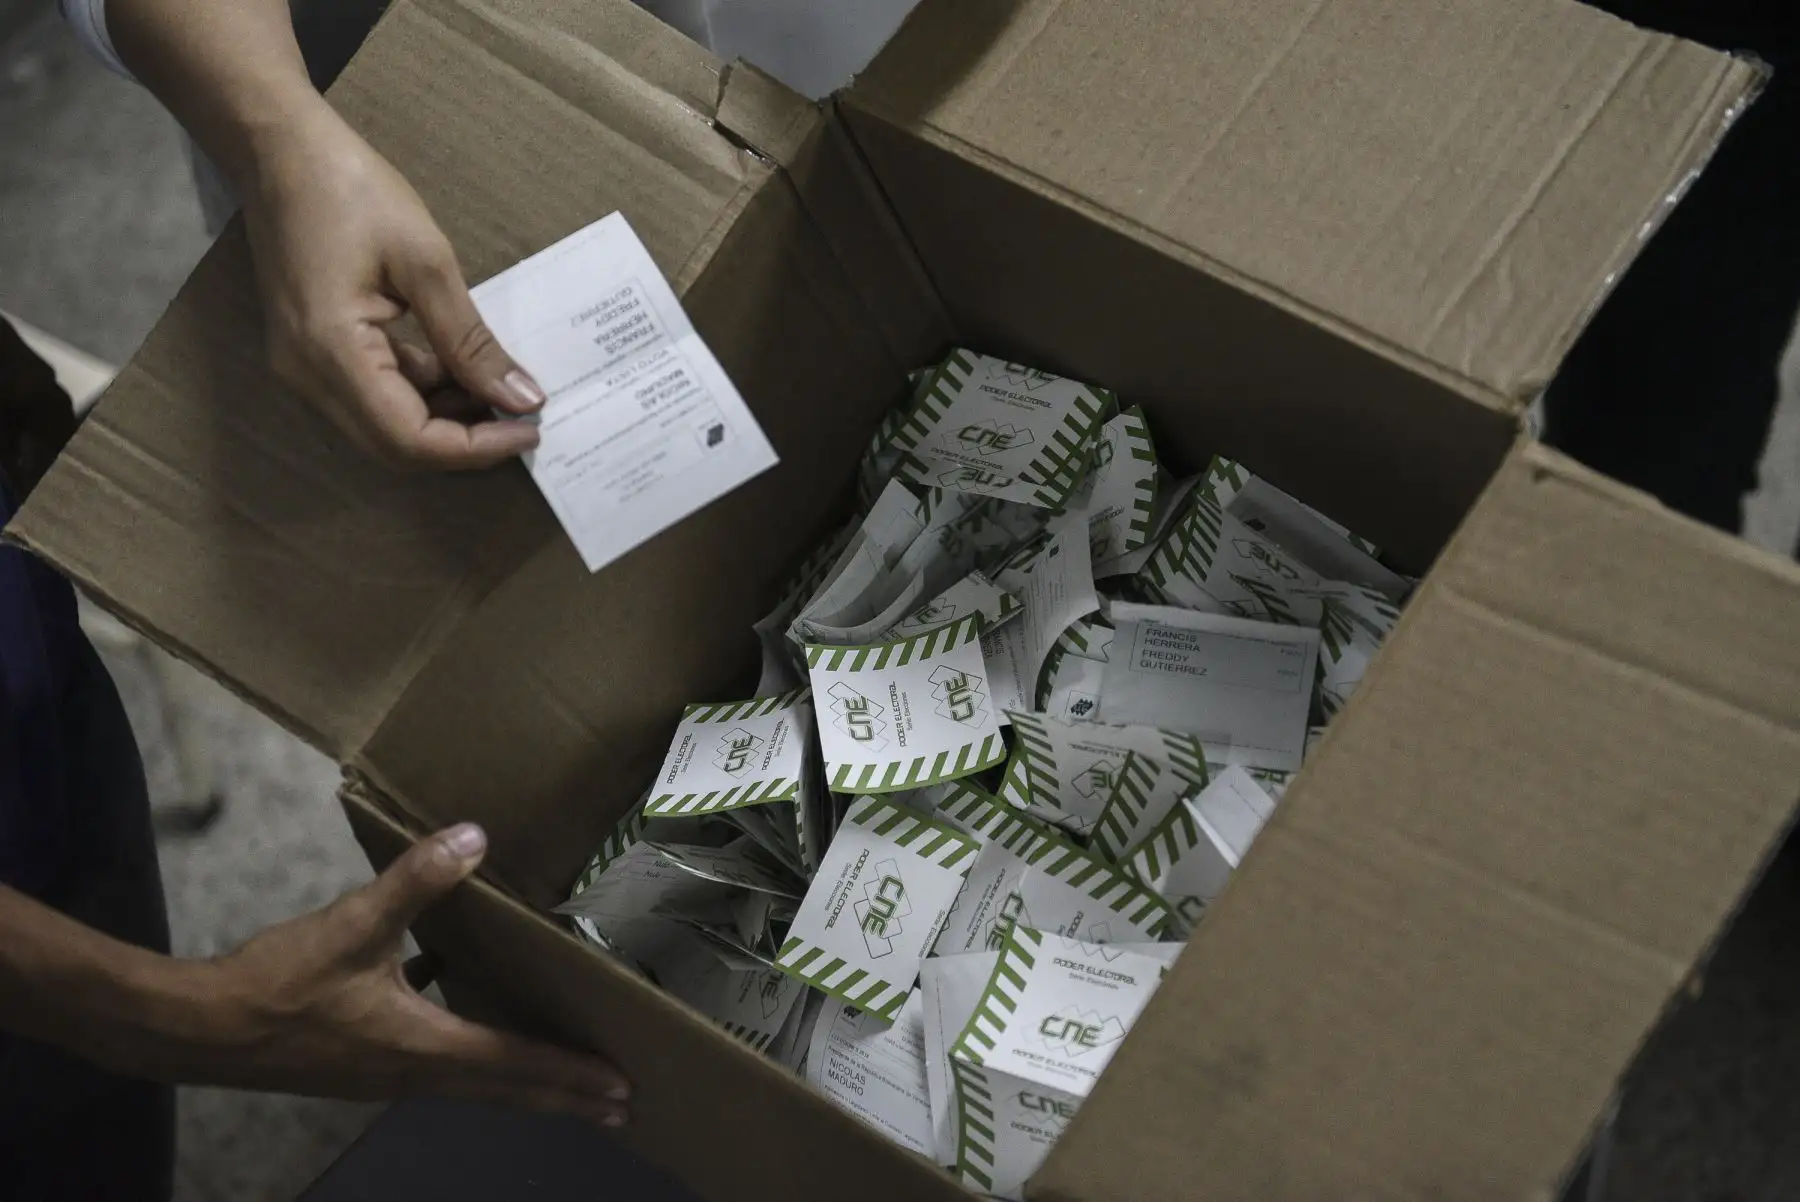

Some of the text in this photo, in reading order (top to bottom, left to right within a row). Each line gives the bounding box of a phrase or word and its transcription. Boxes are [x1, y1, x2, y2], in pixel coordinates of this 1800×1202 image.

[603, 321, 655, 355] FRANCIS
[958, 424, 1017, 450] CNE
[1144, 638, 1200, 652] HERRERA
[1146, 628, 1197, 643] FRANCIS
[1140, 659, 1209, 676] GUTIERREZ
[1142, 649, 1189, 662] FREDDY
[945, 671, 975, 721] CNE
[843, 695, 875, 742] CNE
[888, 681, 908, 747] PODER ELECTORAL
[768, 716, 786, 750] ELECTORAL
[667, 733, 692, 785] PODER ELECTORAL
[723, 734, 754, 772] CNE
[824, 848, 870, 931] PODER ELECTORAL
[861, 875, 904, 937] CNE
[1053, 957, 1137, 985] PODER ELECTORAL
[1039, 1014, 1105, 1048] CNE
[827, 1069, 864, 1097] MADURO
[829, 1057, 866, 1085] NICOLAS
[1019, 1090, 1075, 1118] CNE
